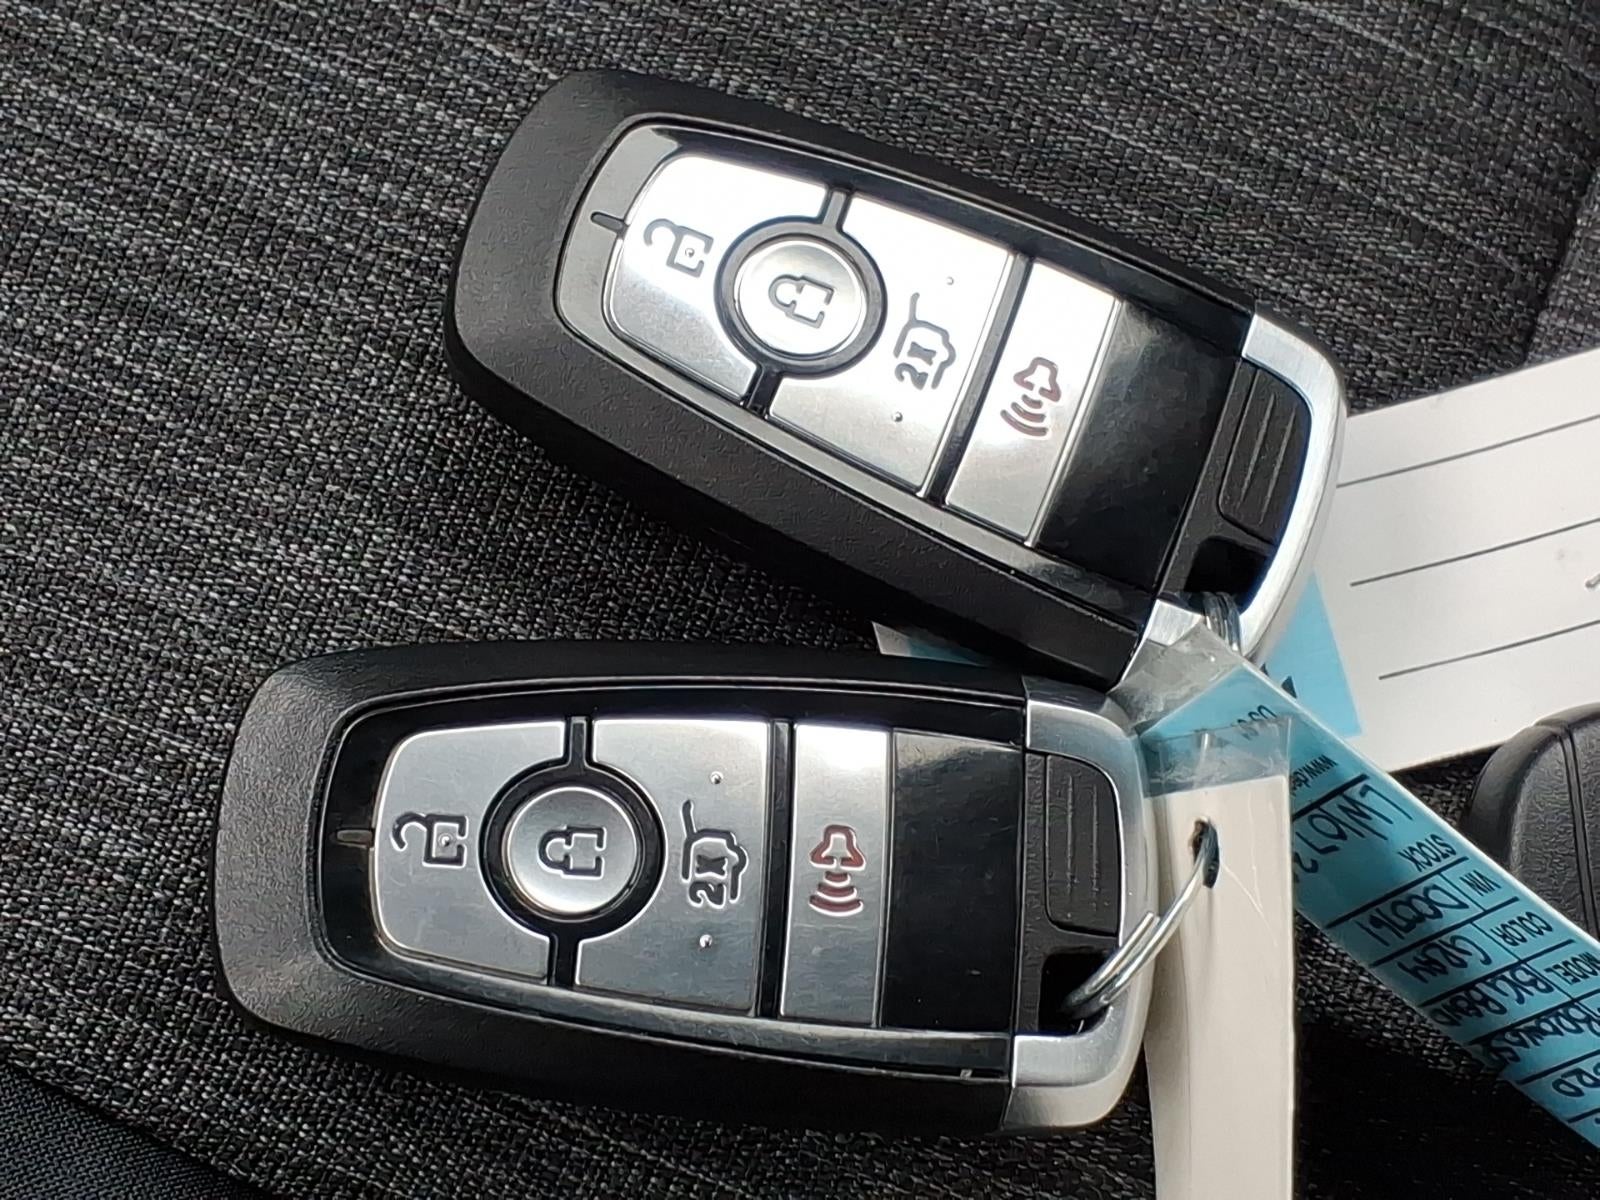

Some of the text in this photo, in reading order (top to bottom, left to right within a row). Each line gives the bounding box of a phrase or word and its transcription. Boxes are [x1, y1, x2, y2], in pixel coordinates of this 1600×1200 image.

[1398, 834, 1457, 872] STOCK
[1459, 869, 1502, 896] VIN
[1490, 911, 1553, 946] COLOR
[1396, 935, 1492, 984] GRAY
[1544, 952, 1600, 985] MODEL
